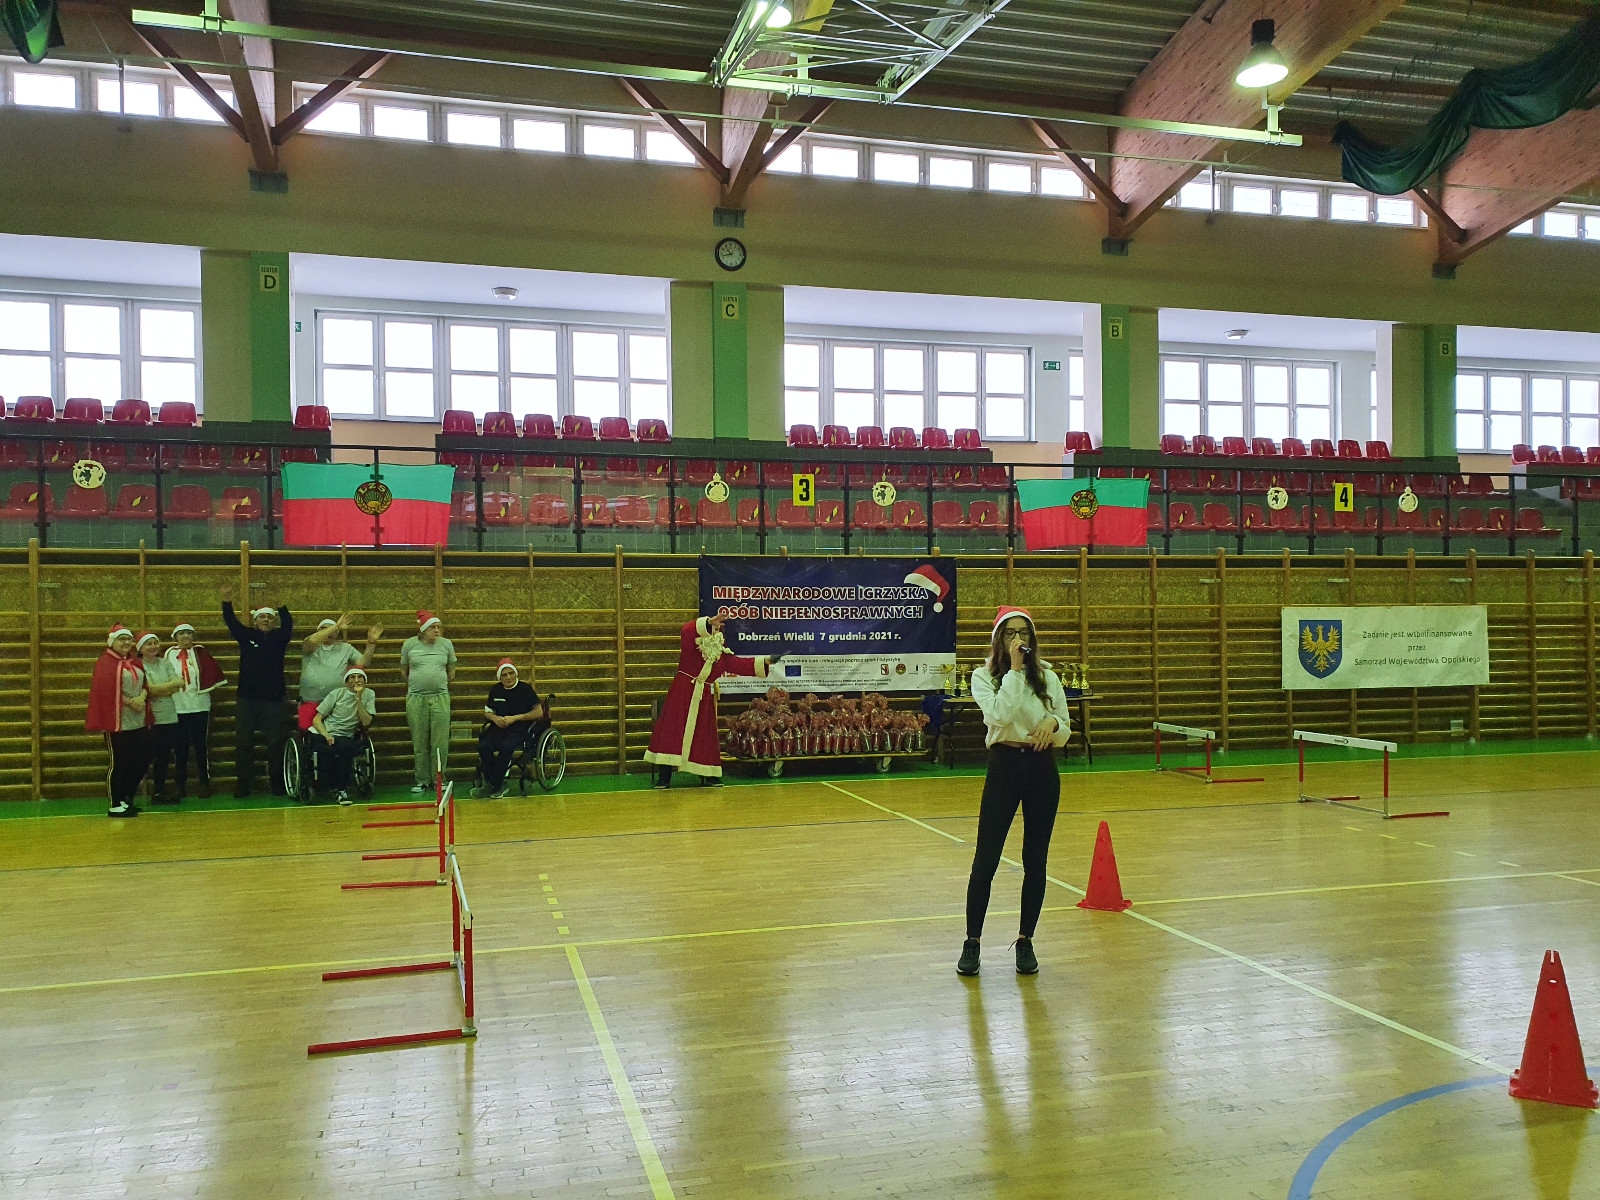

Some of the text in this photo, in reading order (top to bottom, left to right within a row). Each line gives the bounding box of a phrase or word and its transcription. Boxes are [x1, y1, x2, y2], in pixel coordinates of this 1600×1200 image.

[264, 274, 277, 289] D
[725, 303, 735, 317] C
[1111, 325, 1119, 337] B
[799, 478, 810, 501] 3
[1340, 486, 1349, 507] 4
[713, 586, 929, 602] MIĘDZYNARODOWE IGRZYSKA
[718, 603, 924, 620] OSÓB NIEPEŁNOSPRAWNYCH
[738, 632, 781, 641] Dobrzeń
[784, 632, 815, 641] Wielki
[819, 632, 826, 641] 7
[828, 632, 867, 643] grudnia
[868, 631, 892, 640] 2021
[1362, 631, 1390, 639] Zadanie
[1390, 630, 1404, 639] jest
[1354, 656, 1481, 667] Samorząd Województwa Opolskiego
